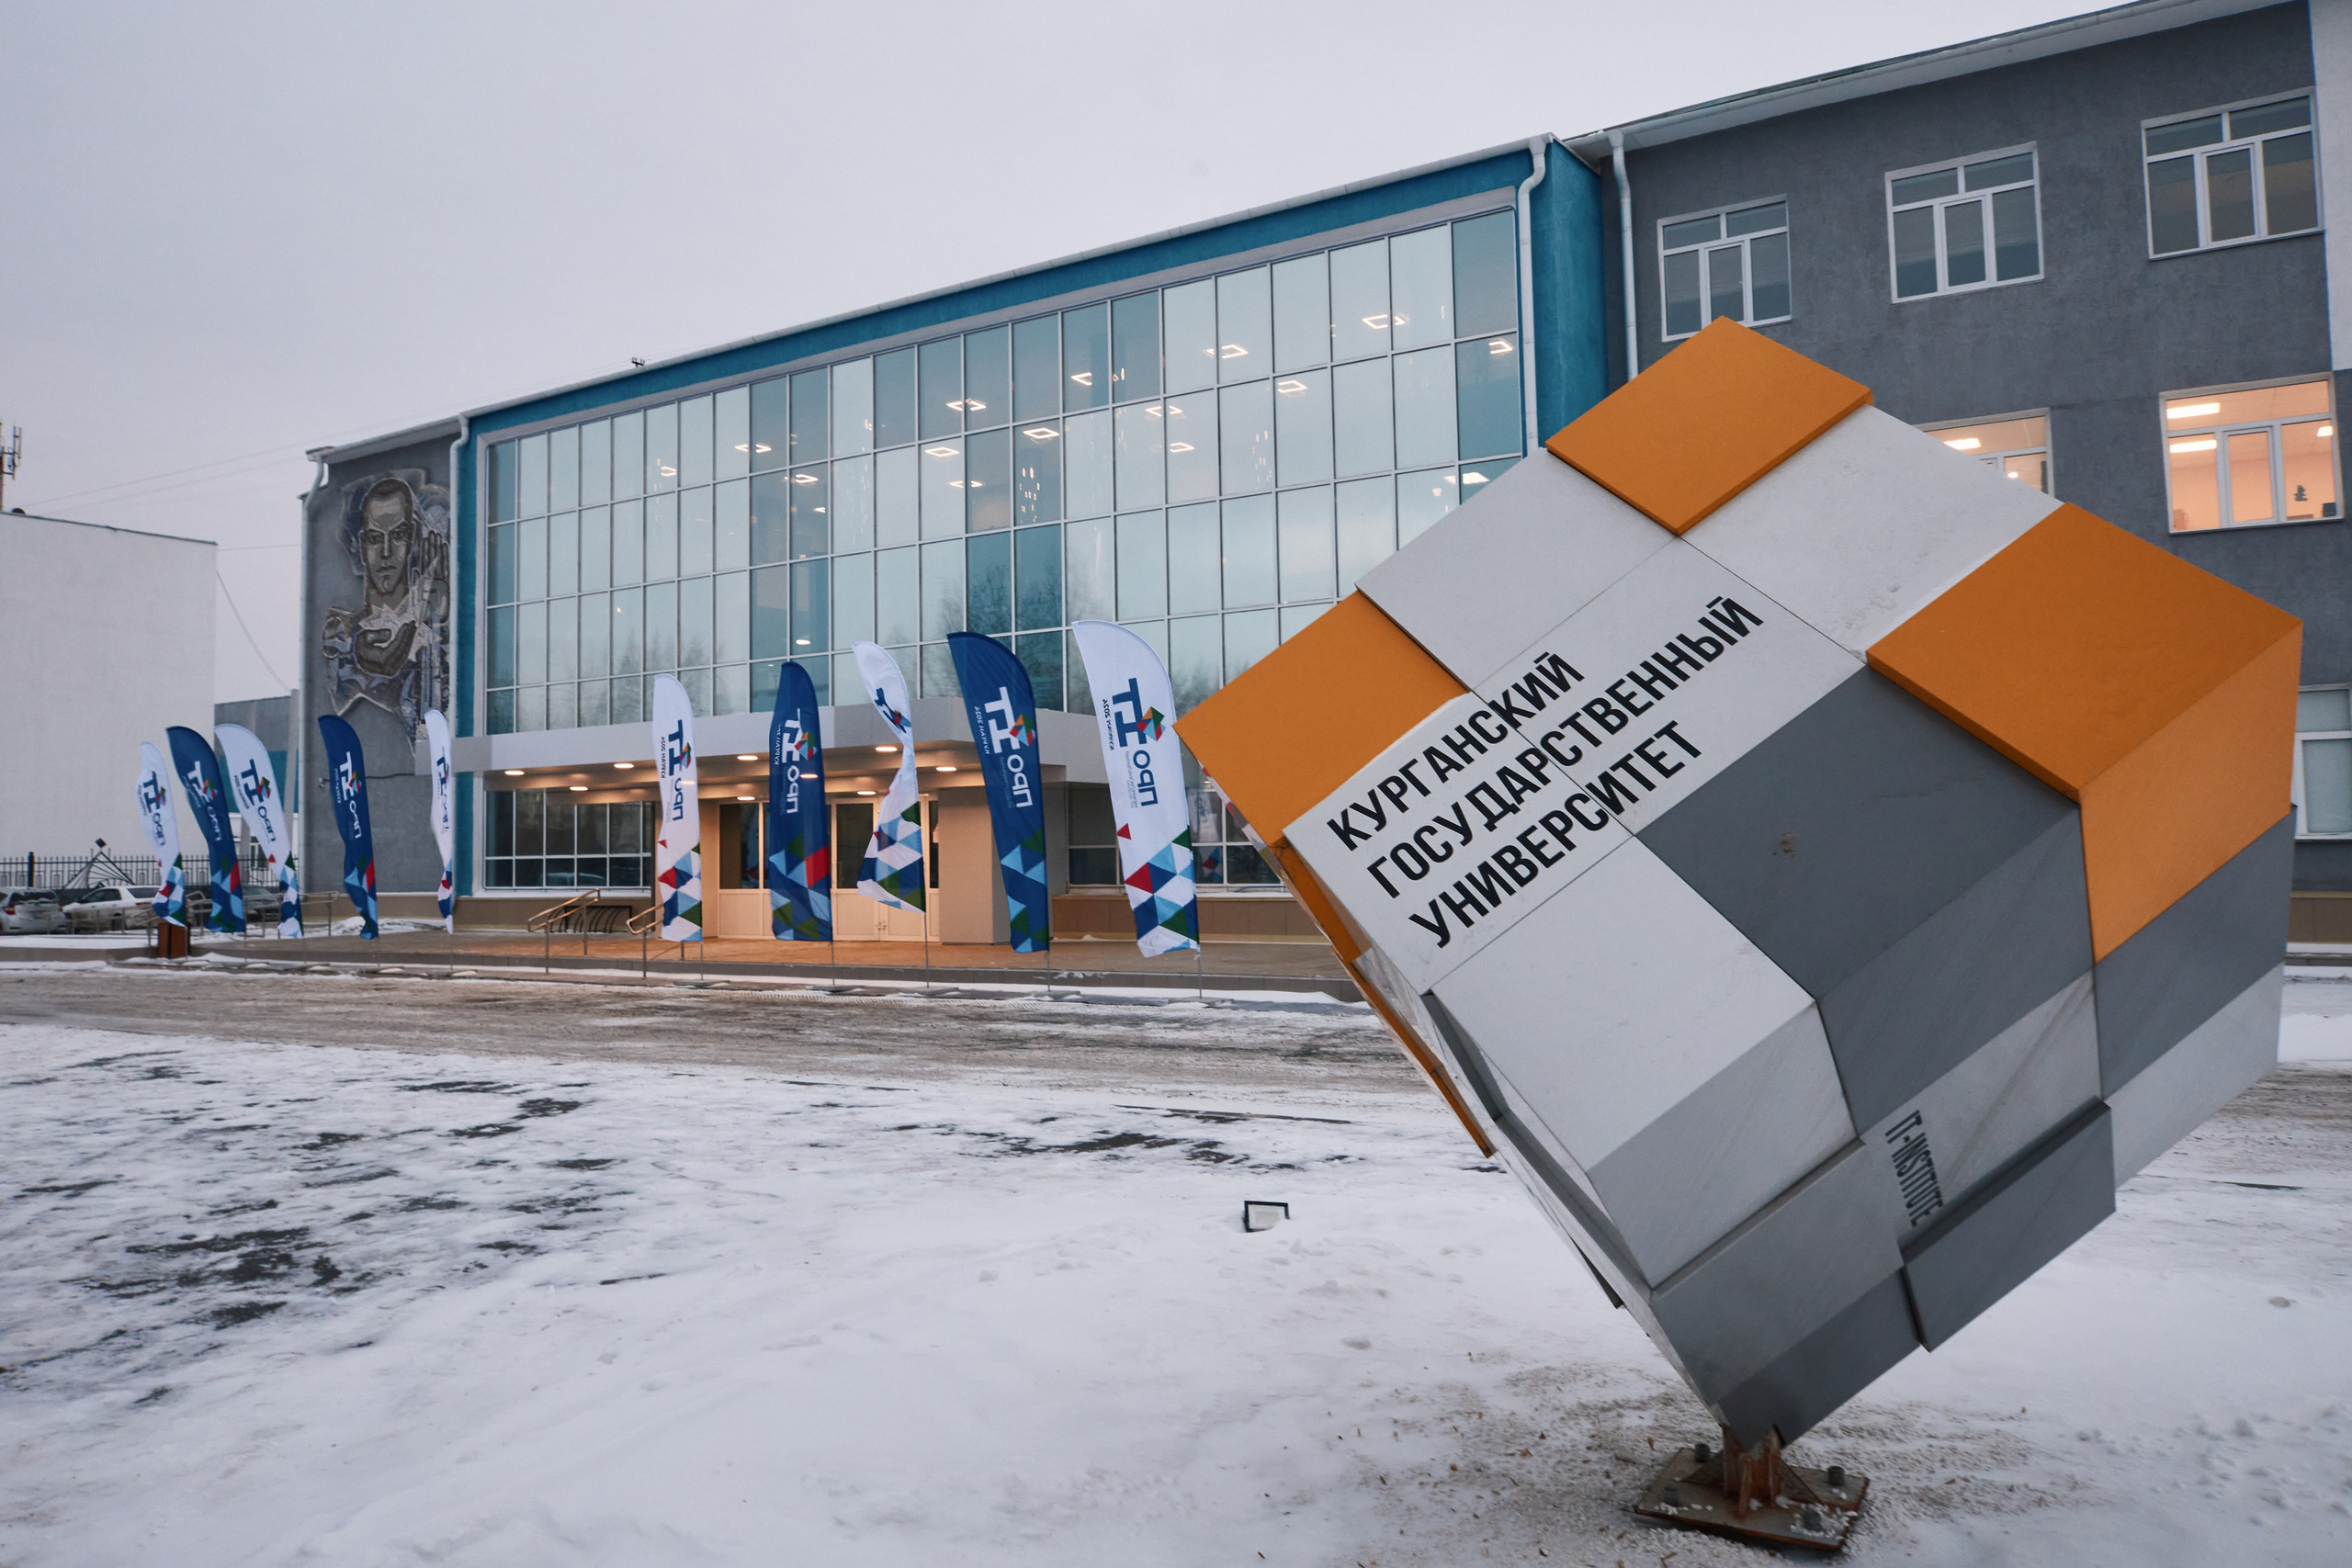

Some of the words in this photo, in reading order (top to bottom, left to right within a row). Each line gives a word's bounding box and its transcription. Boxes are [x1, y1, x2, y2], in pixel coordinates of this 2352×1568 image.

[1327, 651, 1585, 852] КУРГАНСКИЙ
[1367, 595, 1764, 898] ГОСУДАРСТВЕННЫЙ
[1408, 720, 1702, 949] УНИВЕРСИТЕТ
[1884, 1109, 1944, 1227] IT-INSTITUTE
